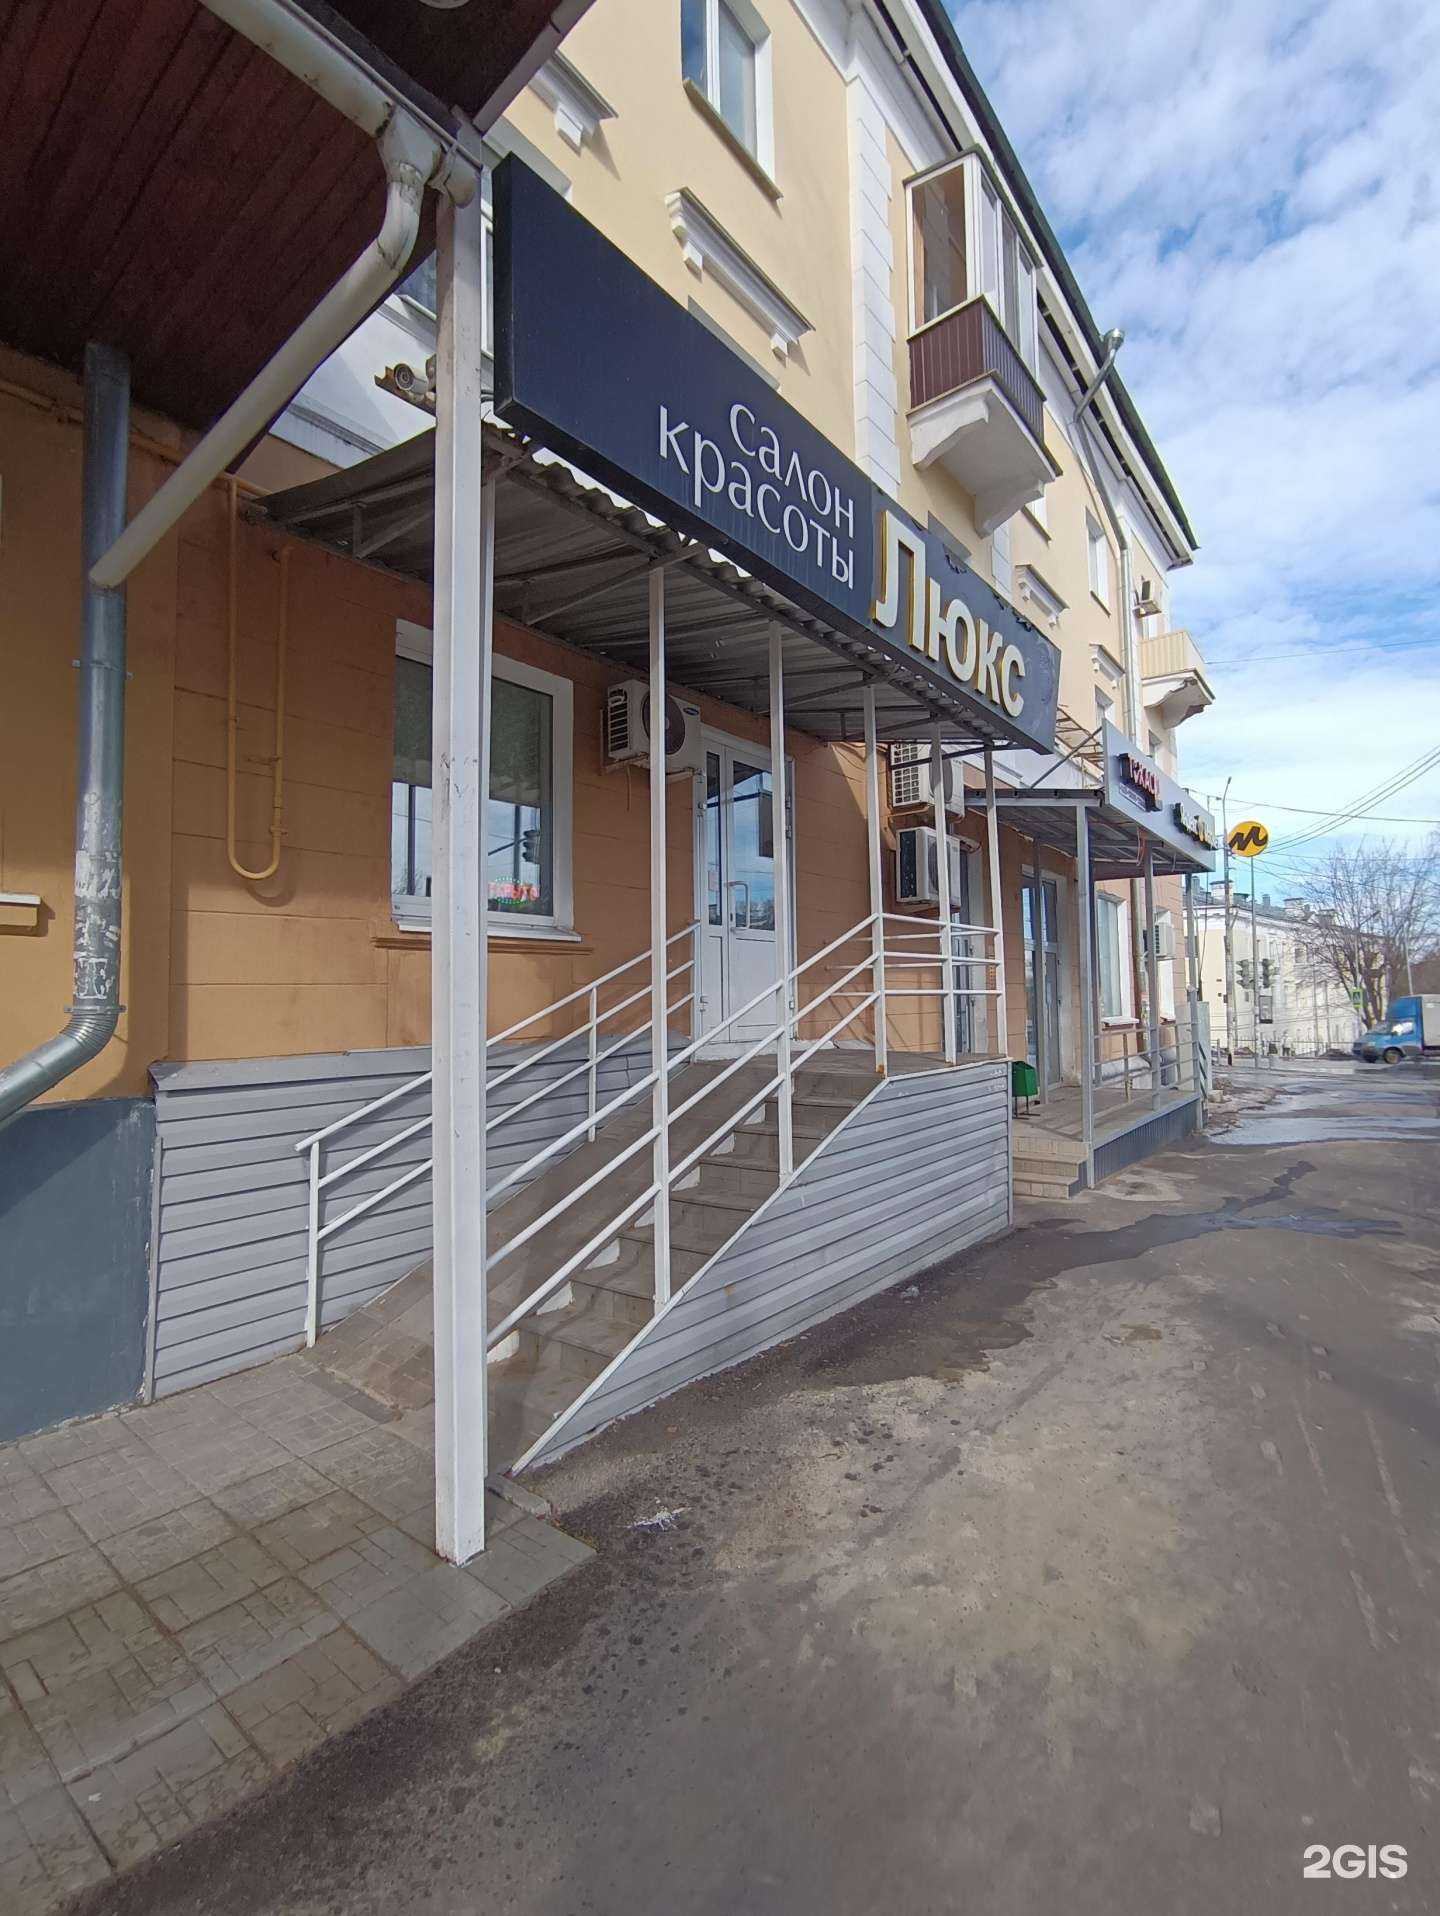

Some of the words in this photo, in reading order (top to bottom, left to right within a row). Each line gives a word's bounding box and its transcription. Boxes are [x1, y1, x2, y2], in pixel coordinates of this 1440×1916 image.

[659, 405, 854, 589] красоты
[729, 403, 854, 538] салон
[872, 509, 1026, 718] Люкс
